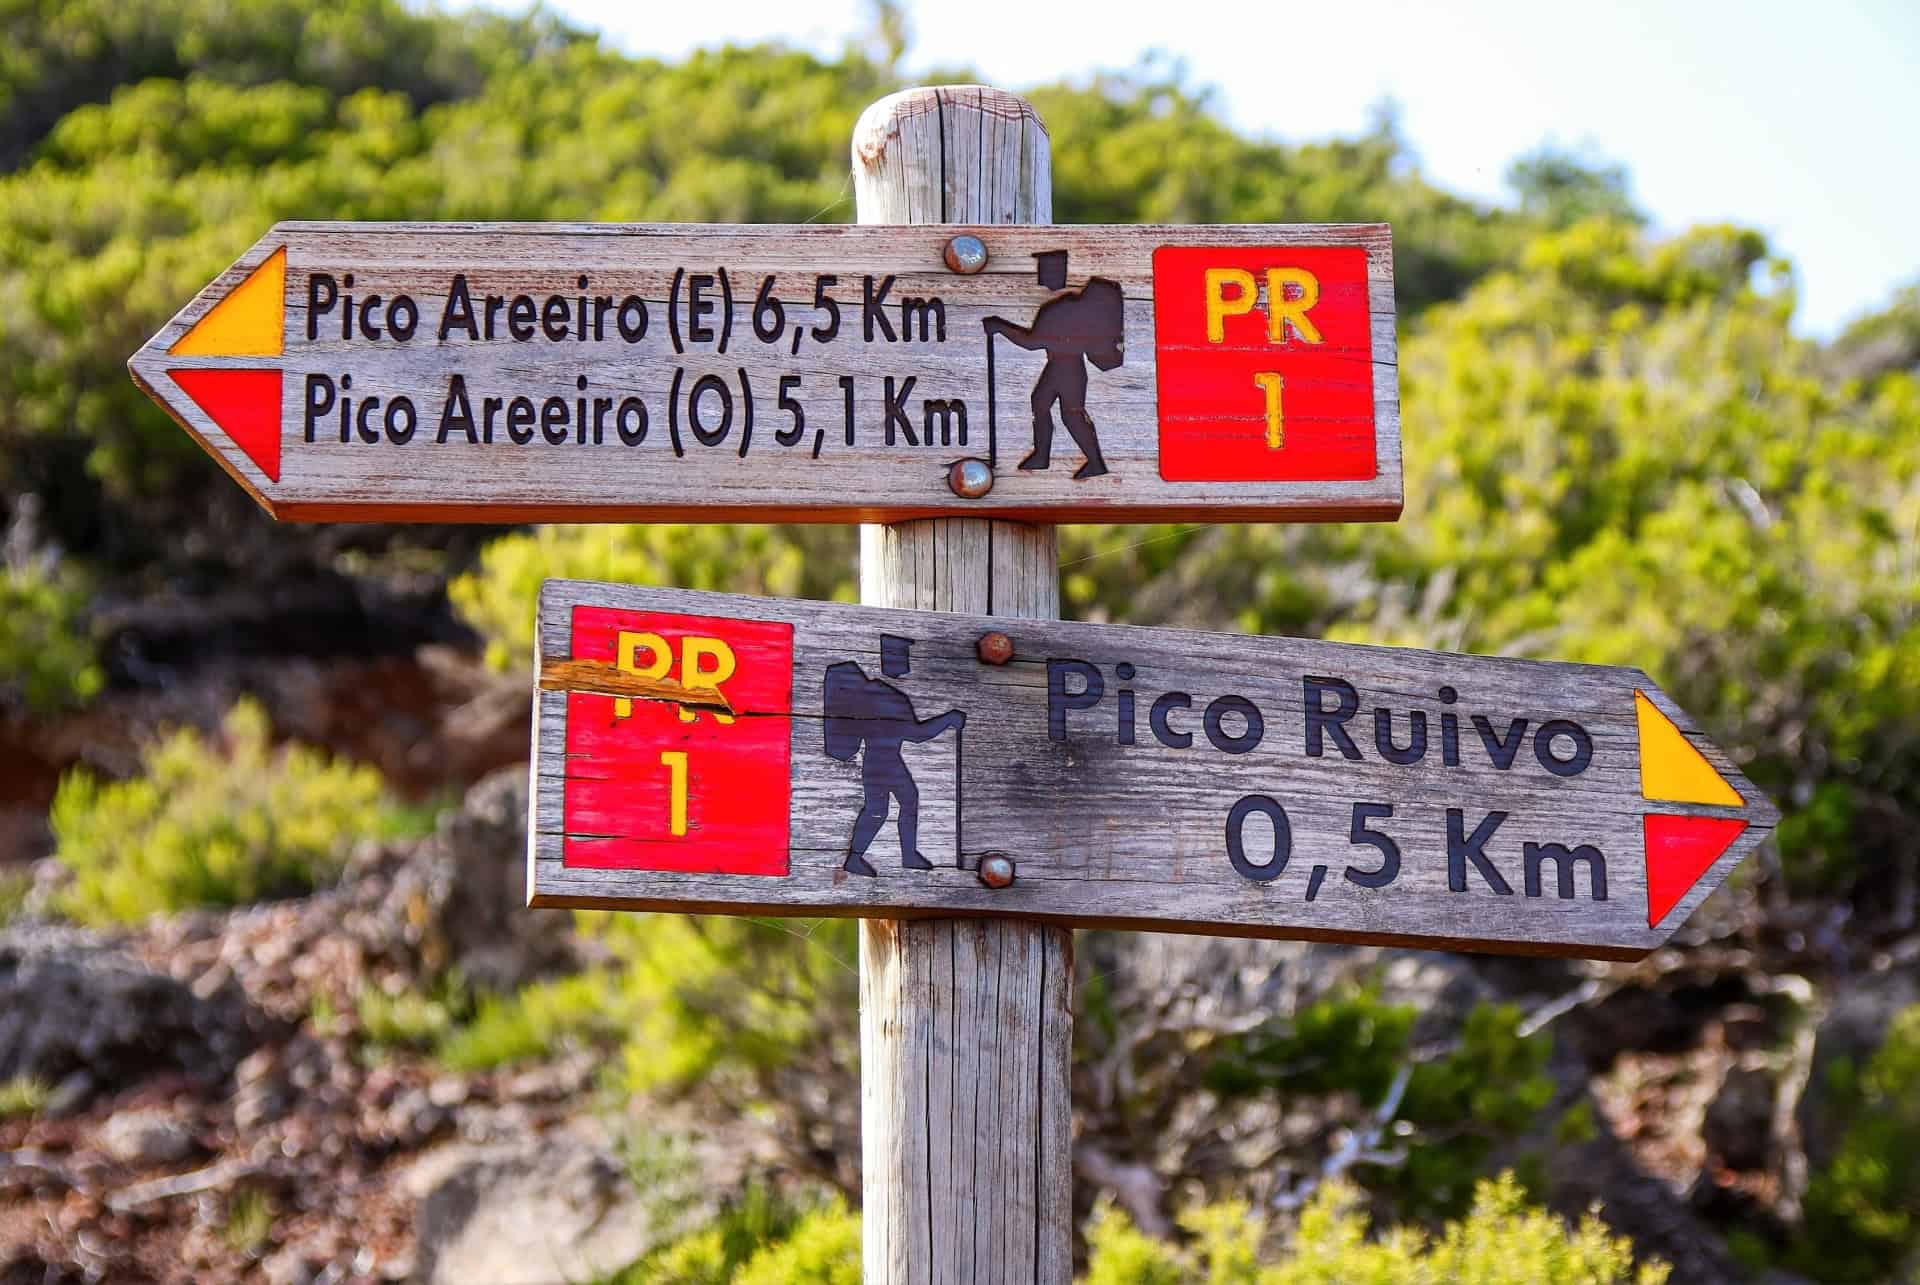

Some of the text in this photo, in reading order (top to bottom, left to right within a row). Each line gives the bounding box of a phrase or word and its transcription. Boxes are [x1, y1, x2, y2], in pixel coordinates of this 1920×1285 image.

[308, 267, 949, 357] Pico Areeiro (E) 6,5 Km
[1205, 267, 1322, 344] PR
[304, 366, 968, 460] Pico Areeiro (O) 5,1 Km
[1255, 370, 1285, 449] 1
[614, 631, 736, 725] PR
[1046, 656, 1595, 778] Pico Ruivo
[660, 750, 690, 838] 1
[1225, 794, 1609, 902] 0,5 Km
